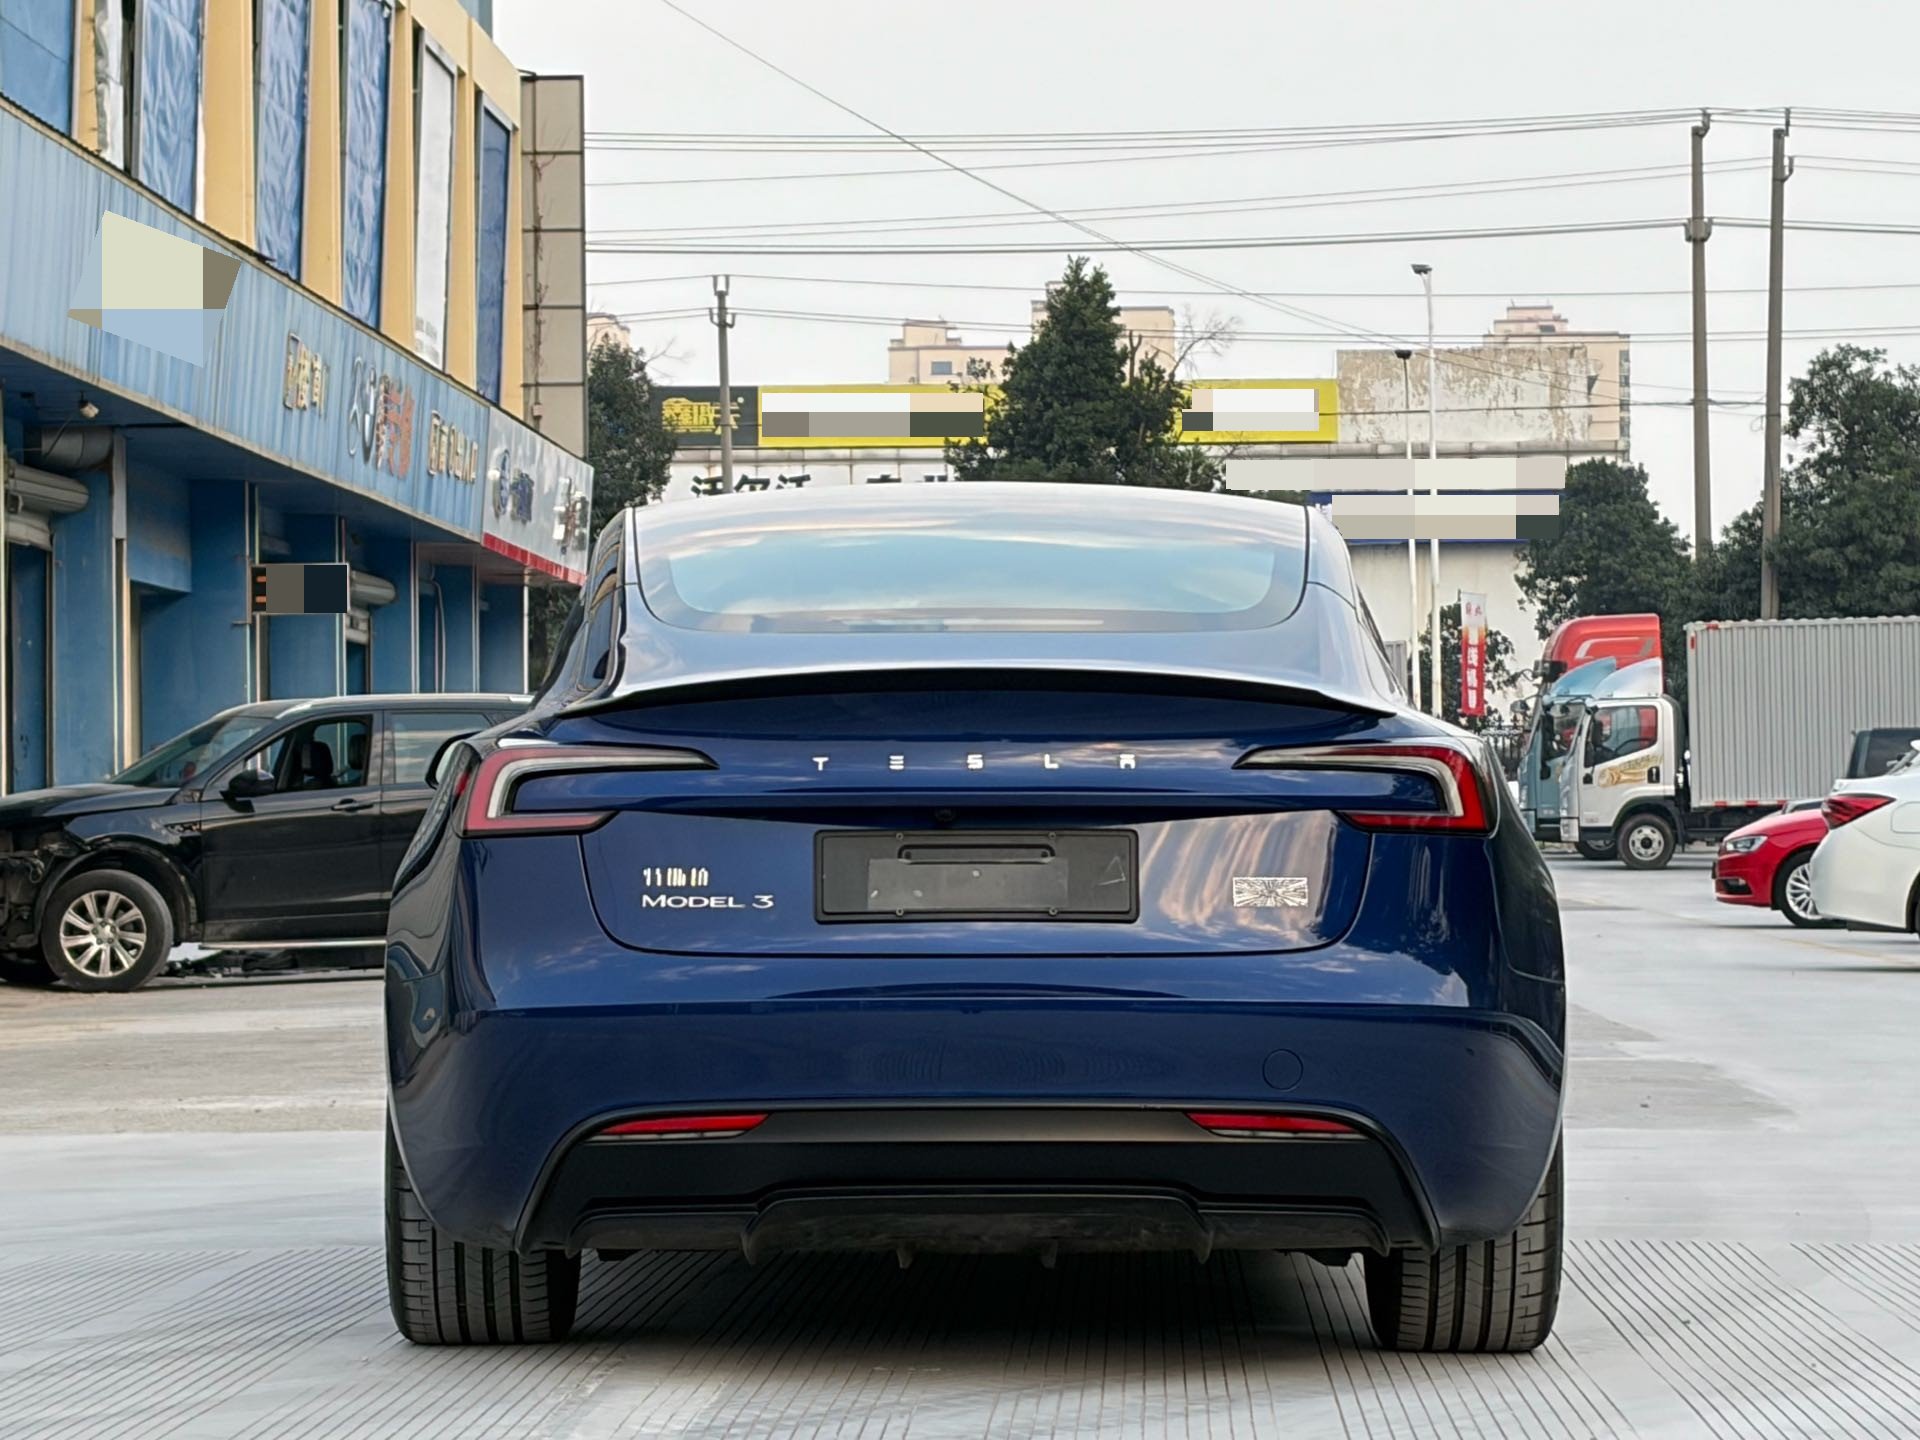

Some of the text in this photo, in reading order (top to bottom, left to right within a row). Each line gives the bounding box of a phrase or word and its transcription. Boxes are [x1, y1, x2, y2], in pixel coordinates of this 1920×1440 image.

[812, 753, 1136, 772] TESLA
[641, 893, 775, 910] MODEL 3
